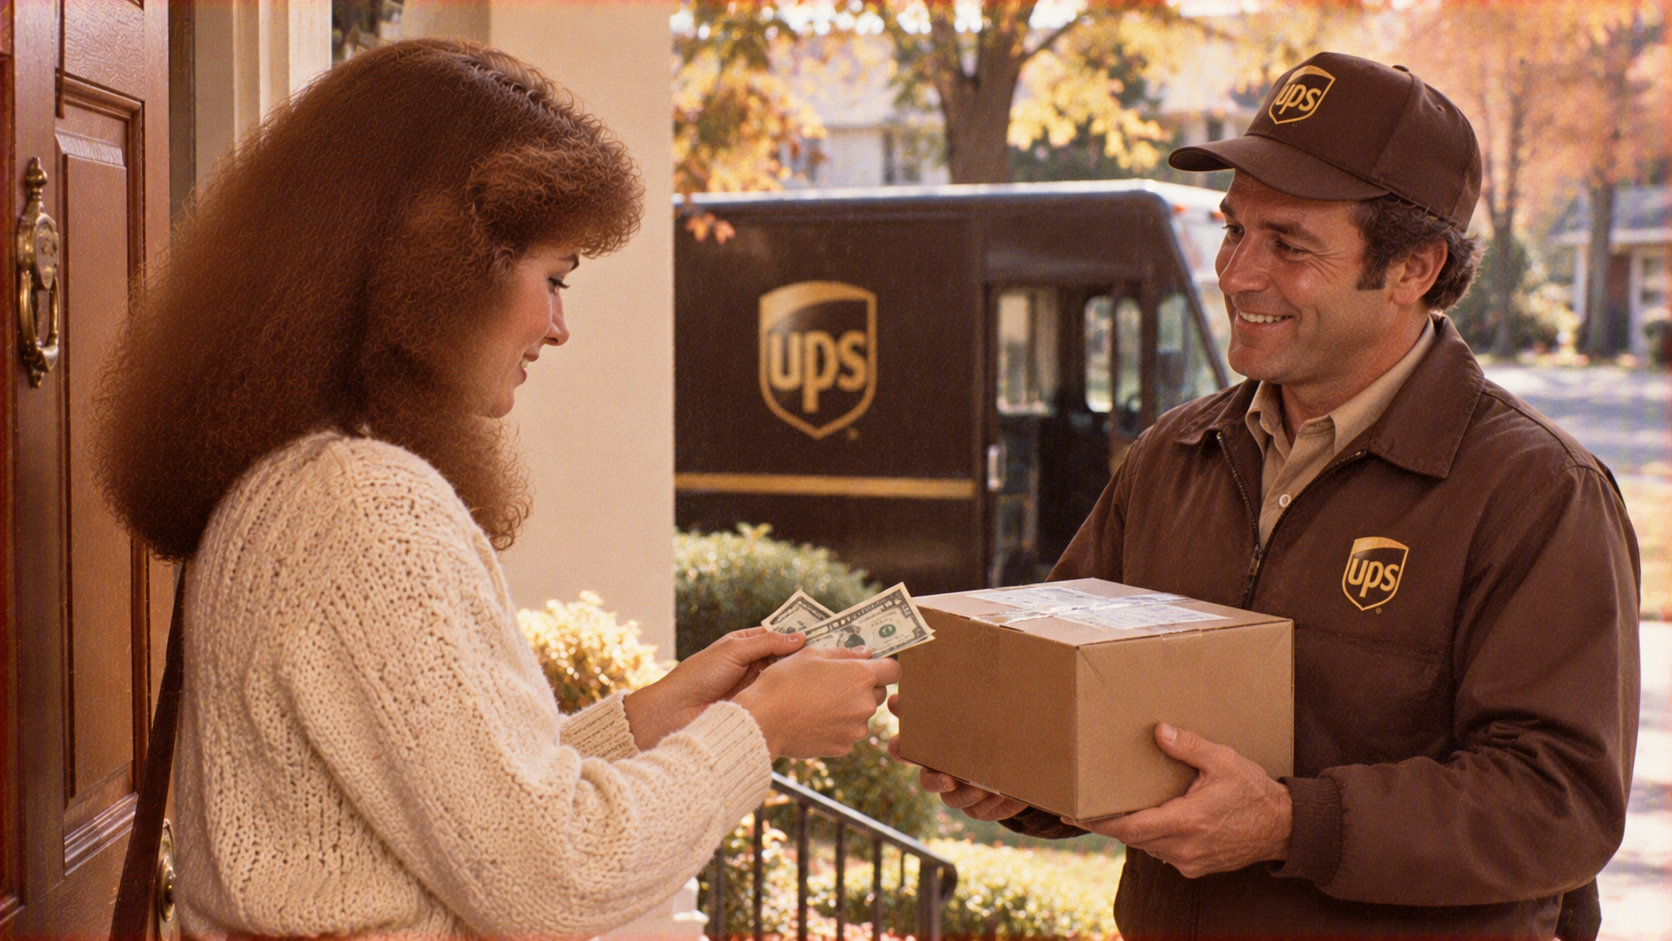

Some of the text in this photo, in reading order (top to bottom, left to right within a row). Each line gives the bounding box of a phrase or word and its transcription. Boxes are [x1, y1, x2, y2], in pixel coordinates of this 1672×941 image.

[1275, 84, 1322, 115] ups
[769, 330, 867, 413] ups
[1348, 558, 1400, 598] ups
